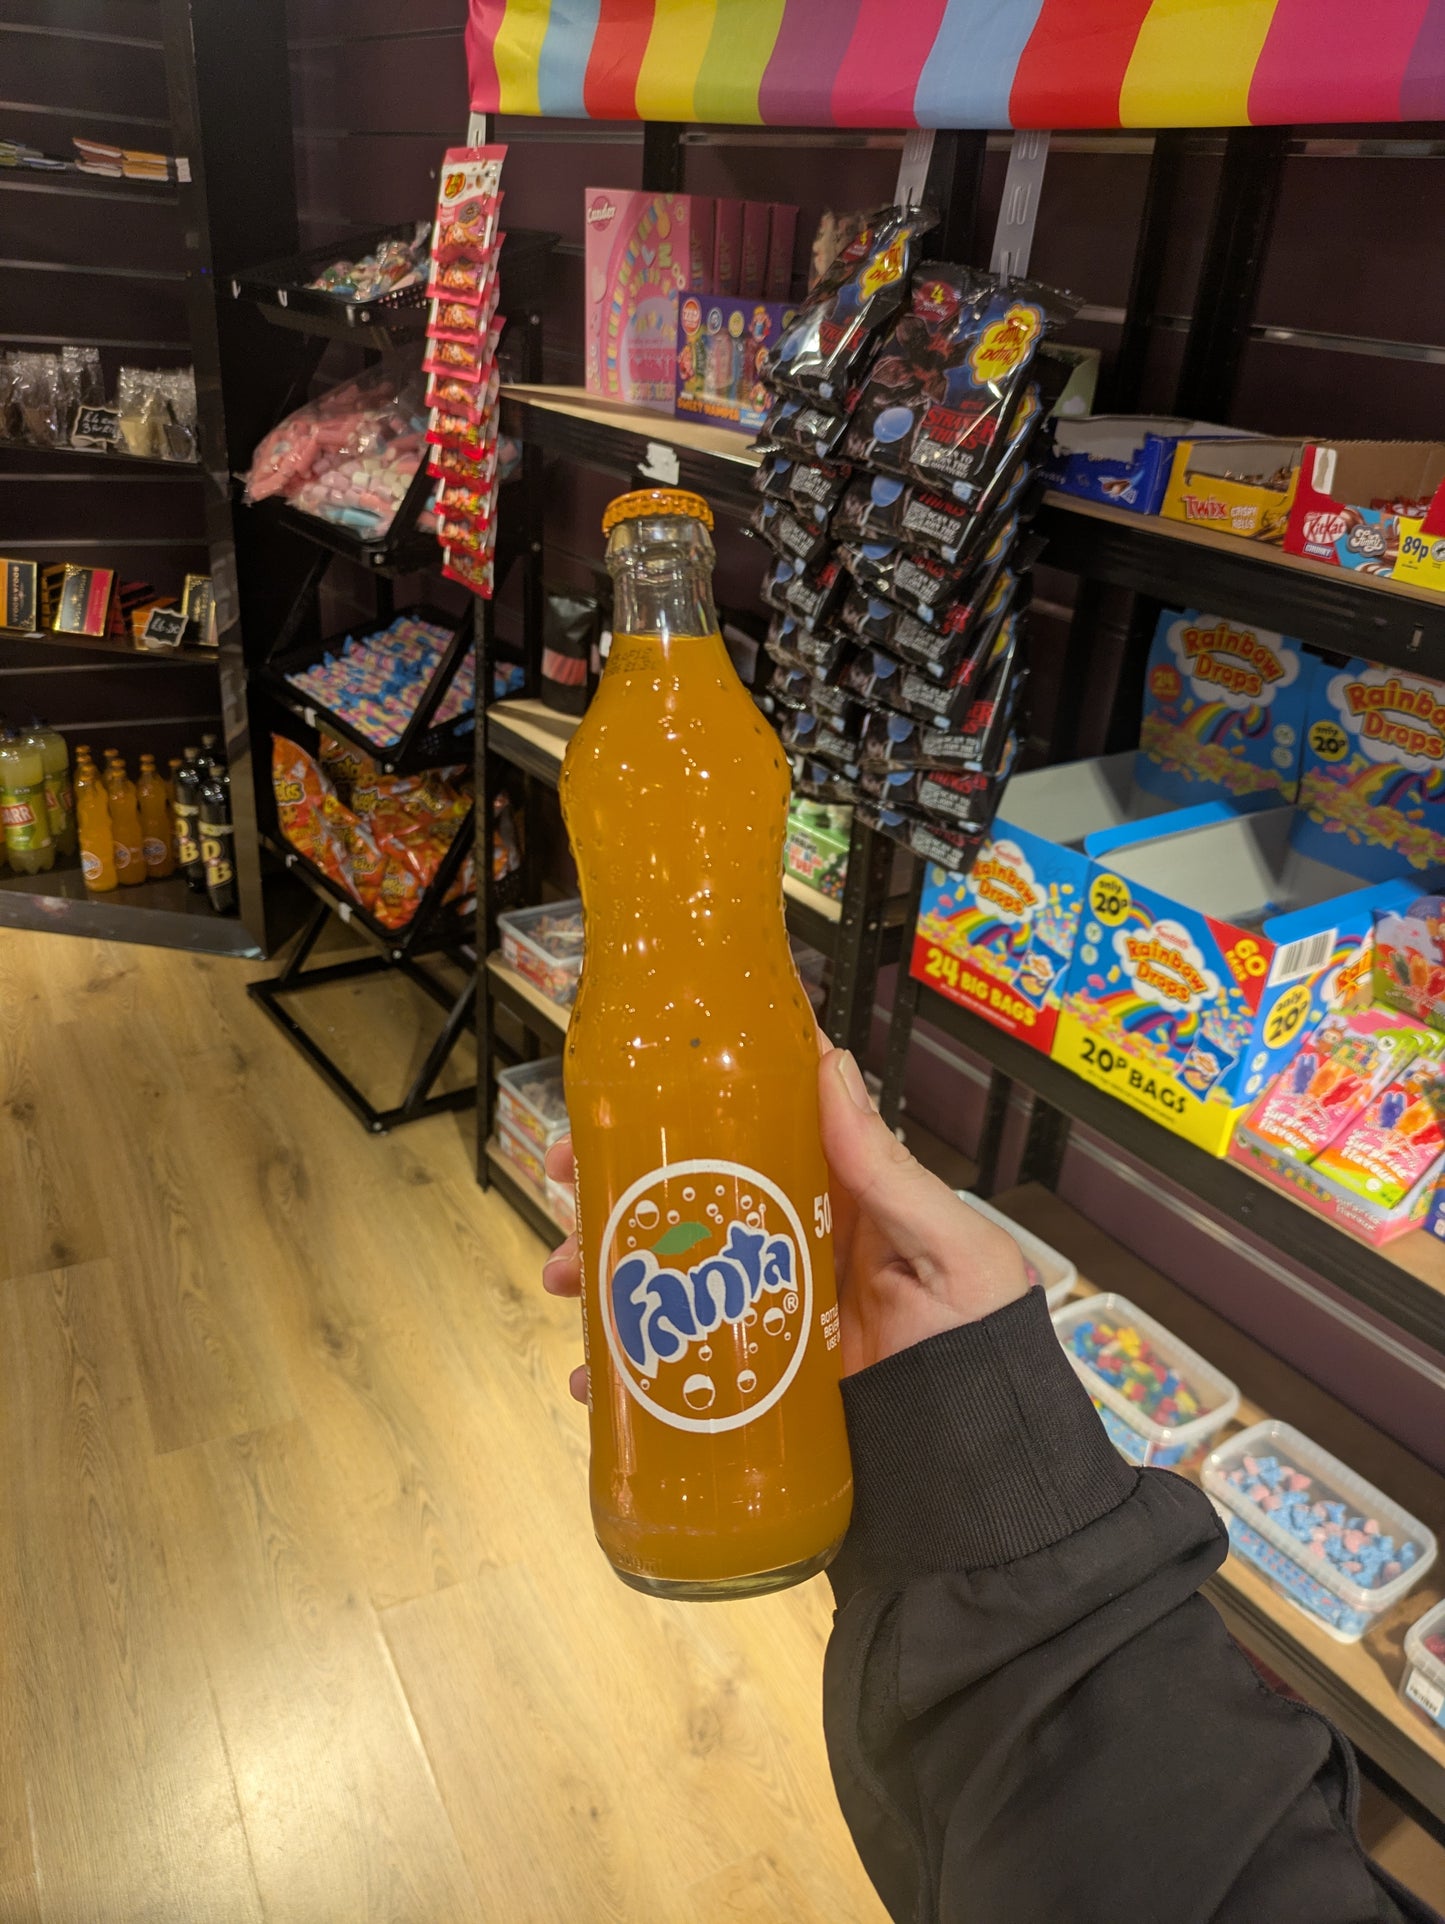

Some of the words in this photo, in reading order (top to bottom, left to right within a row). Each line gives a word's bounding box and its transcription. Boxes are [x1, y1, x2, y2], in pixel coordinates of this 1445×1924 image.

[1303, 514, 1346, 543] KitKat
[1402, 536, 1429, 562] 89p
[1181, 623, 1284, 684] Rainbow
[1192, 653, 1263, 698] Drops
[1343, 679, 1445, 733] Rainbo
[1360, 708, 1445, 761] Drops
[1, 804, 34, 825] ARR
[972, 857, 1039, 907] ainbow
[978, 877, 1025, 917] Drops
[1097, 879, 1123, 895] only
[1125, 937, 1209, 995] Rainbow
[1233, 938, 1269, 978] 60
[923, 946, 960, 989] 24
[960, 970, 990, 1001] BIG
[989, 987, 1037, 1028] BAGS
[1135, 959, 1192, 1004] Drops
[1127, 1068, 1187, 1115] BAGS
[814, 1191, 833, 1239] 50
